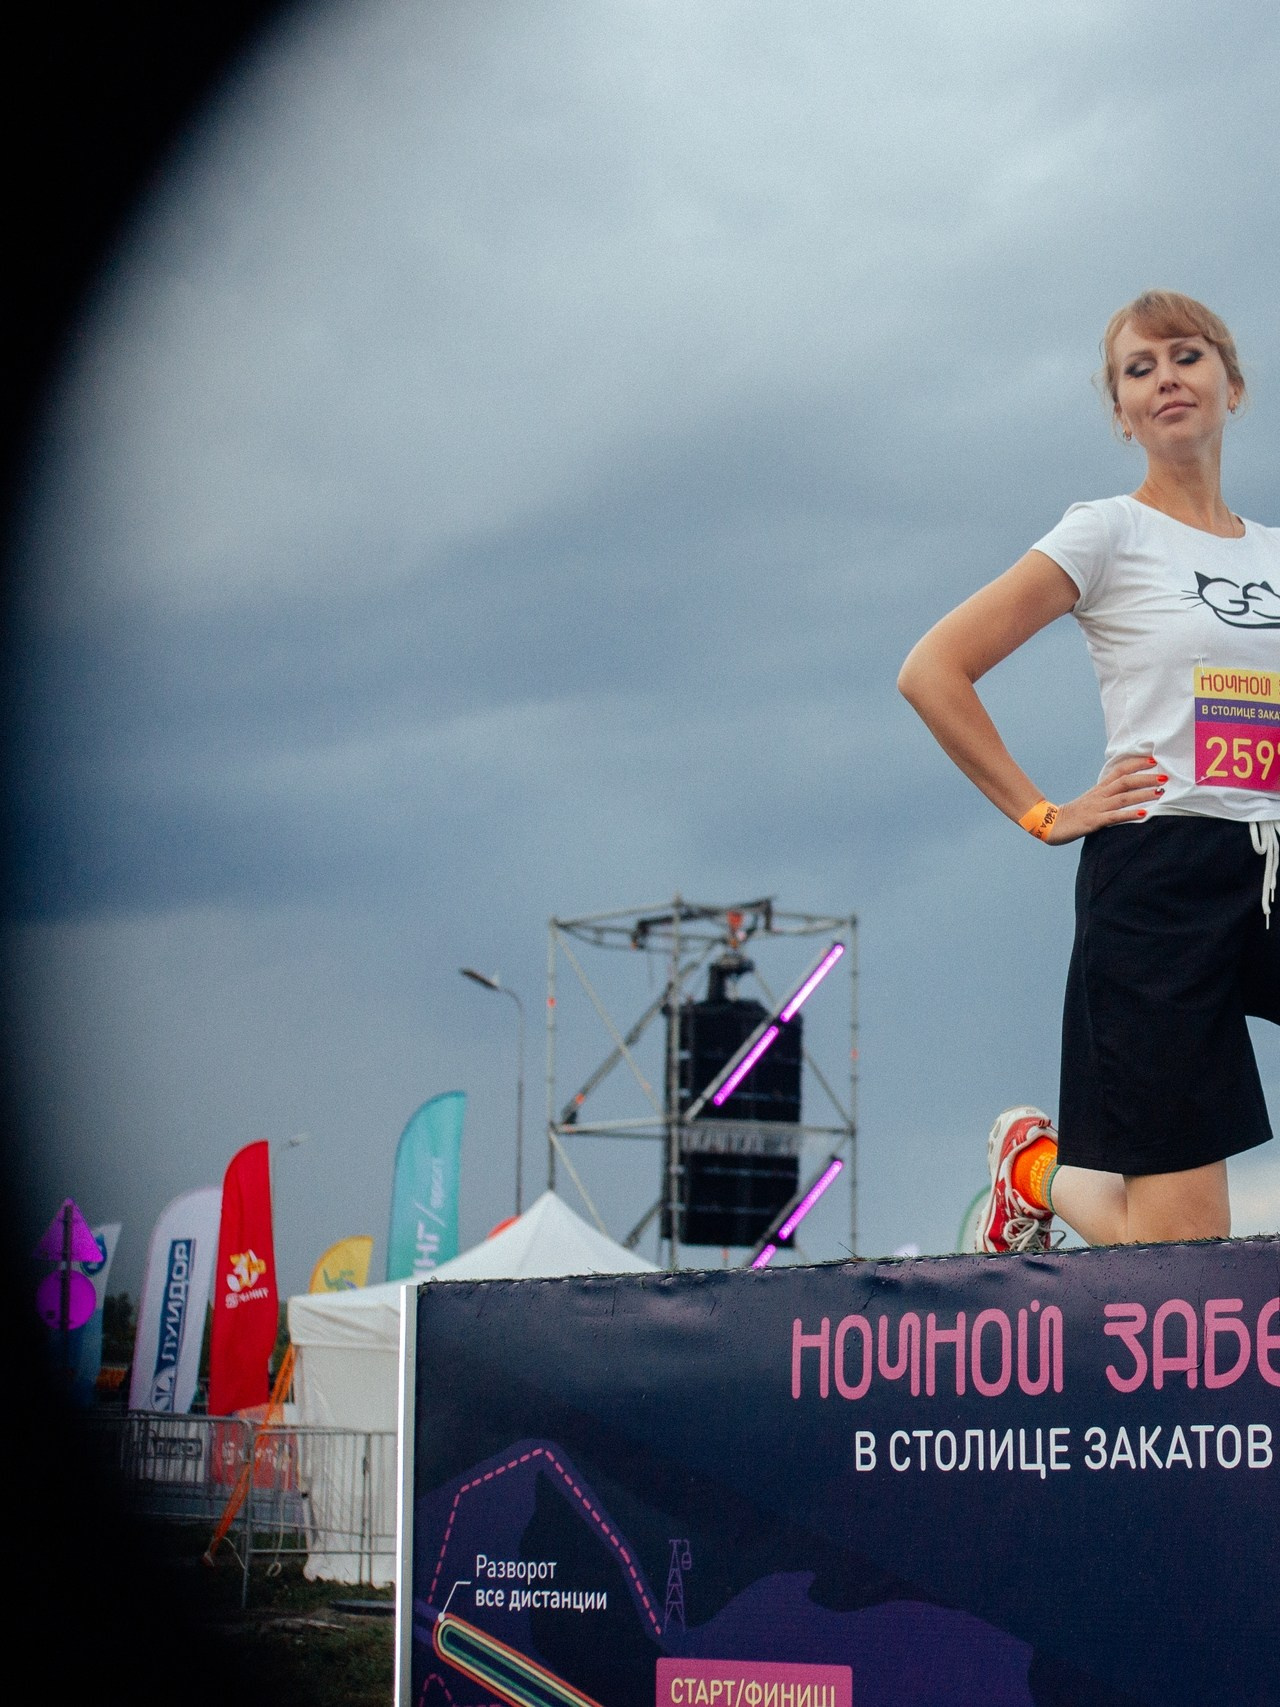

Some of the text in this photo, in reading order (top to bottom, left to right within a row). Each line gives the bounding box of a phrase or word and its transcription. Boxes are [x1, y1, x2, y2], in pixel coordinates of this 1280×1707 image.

[1200, 674, 1270, 697] НОЧНОЙ
[1202, 704, 1209, 715] В
[1211, 705, 1256, 719] СТОЛИЦЕ
[162, 1241, 189, 1361] ЛУИДОР
[791, 1299, 1064, 1401] НОЧНОЙ
[855, 1424, 1274, 1480] В СТОЛИЦЕ ЗАКАТОВ
[476, 1554, 557, 1585] Разворот
[475, 1588, 608, 1613] все дистанции
[670, 1677, 836, 1707] СТАРТ/ФИНИШ
